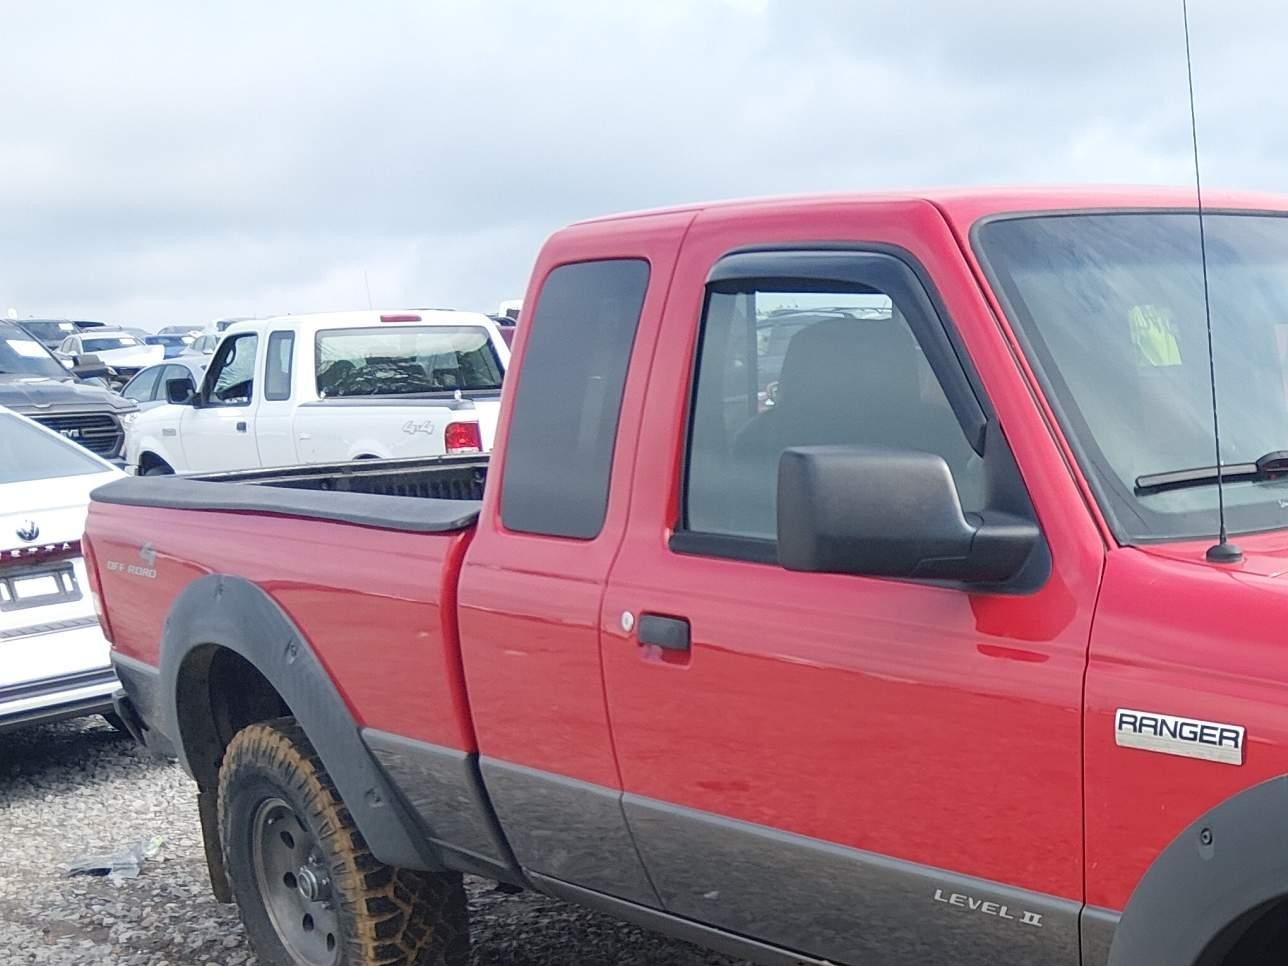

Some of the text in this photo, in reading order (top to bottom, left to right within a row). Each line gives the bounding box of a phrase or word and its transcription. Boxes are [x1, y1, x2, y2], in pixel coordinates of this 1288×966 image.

[107, 560, 157, 579] OFF ROAD
[1117, 712, 1240, 749] RANGER
[933, 888, 1043, 928] LEVEL II
